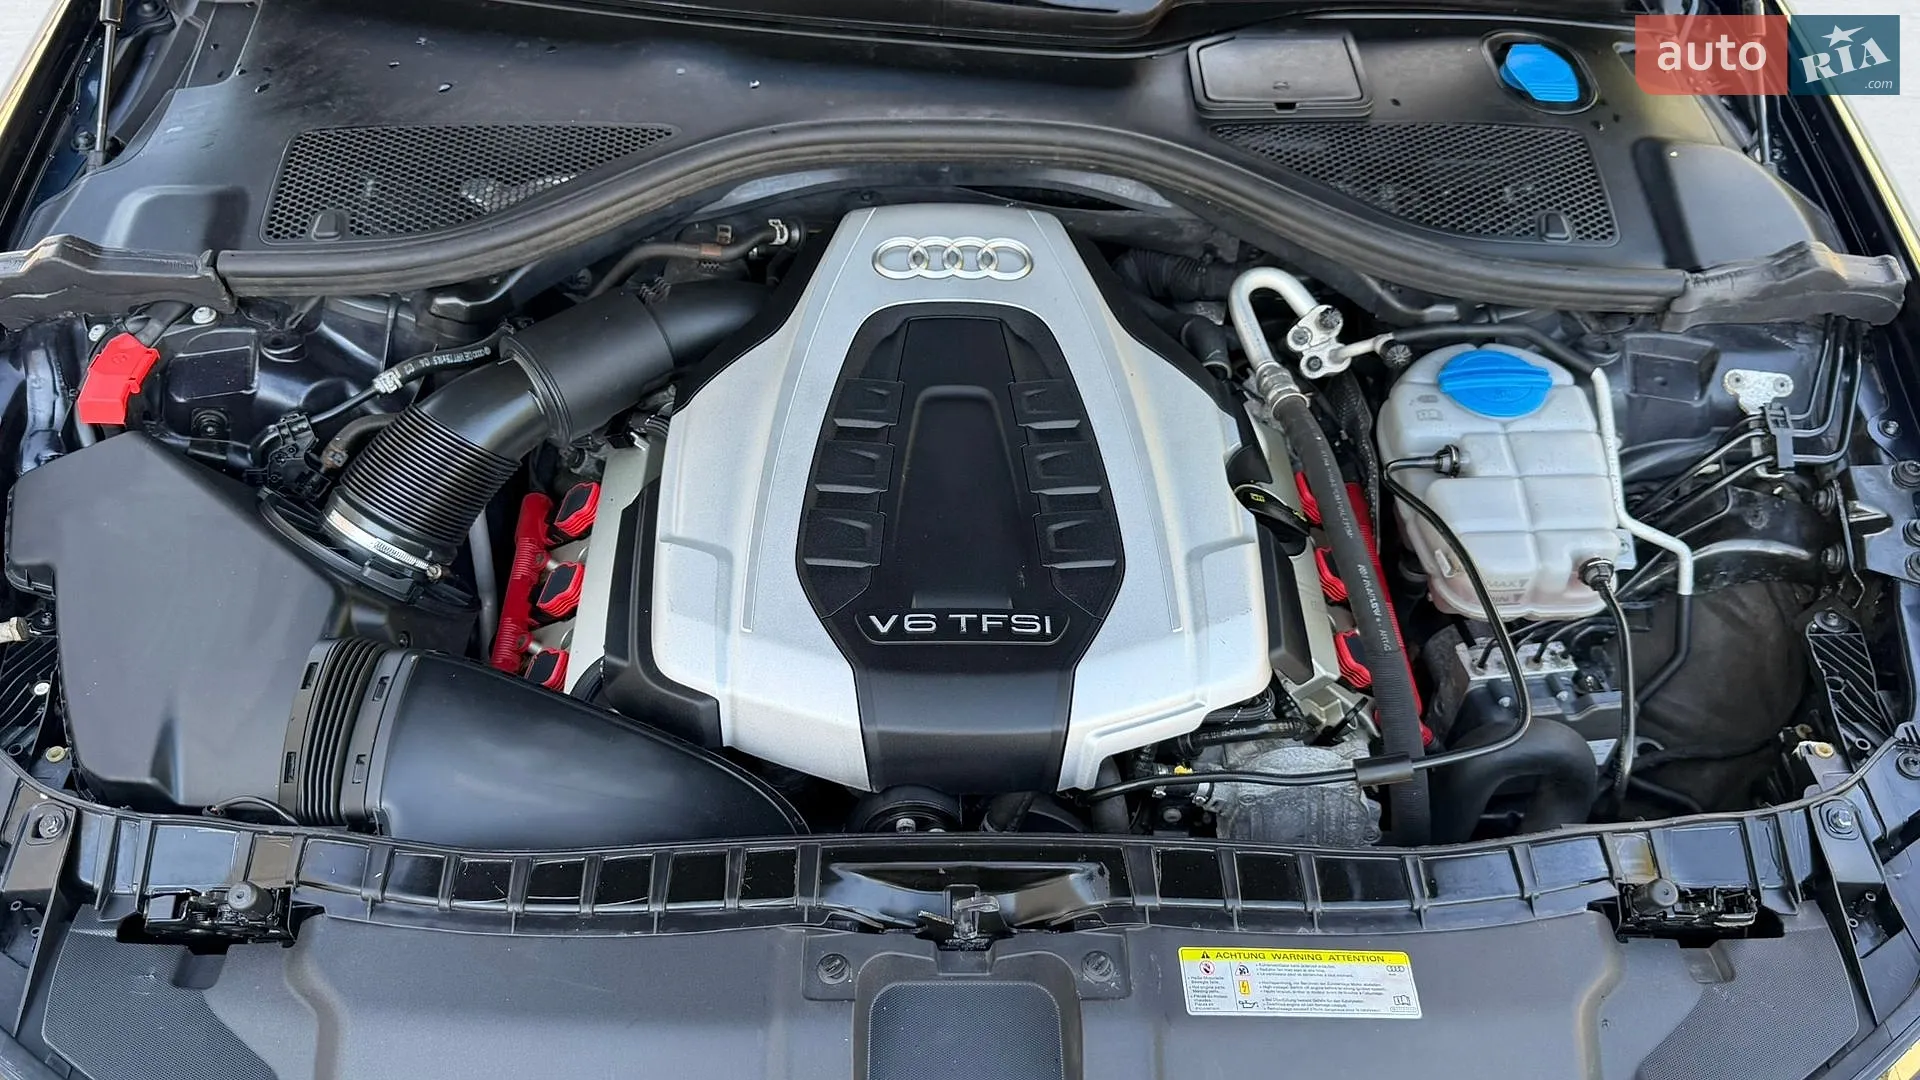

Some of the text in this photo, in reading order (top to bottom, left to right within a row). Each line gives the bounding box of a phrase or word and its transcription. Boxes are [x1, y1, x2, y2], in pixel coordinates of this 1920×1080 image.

[868, 613, 1052, 634] V6 TFSI
[1215, 952, 1385, 962] ACHTUNG WARNING ATTENTION
